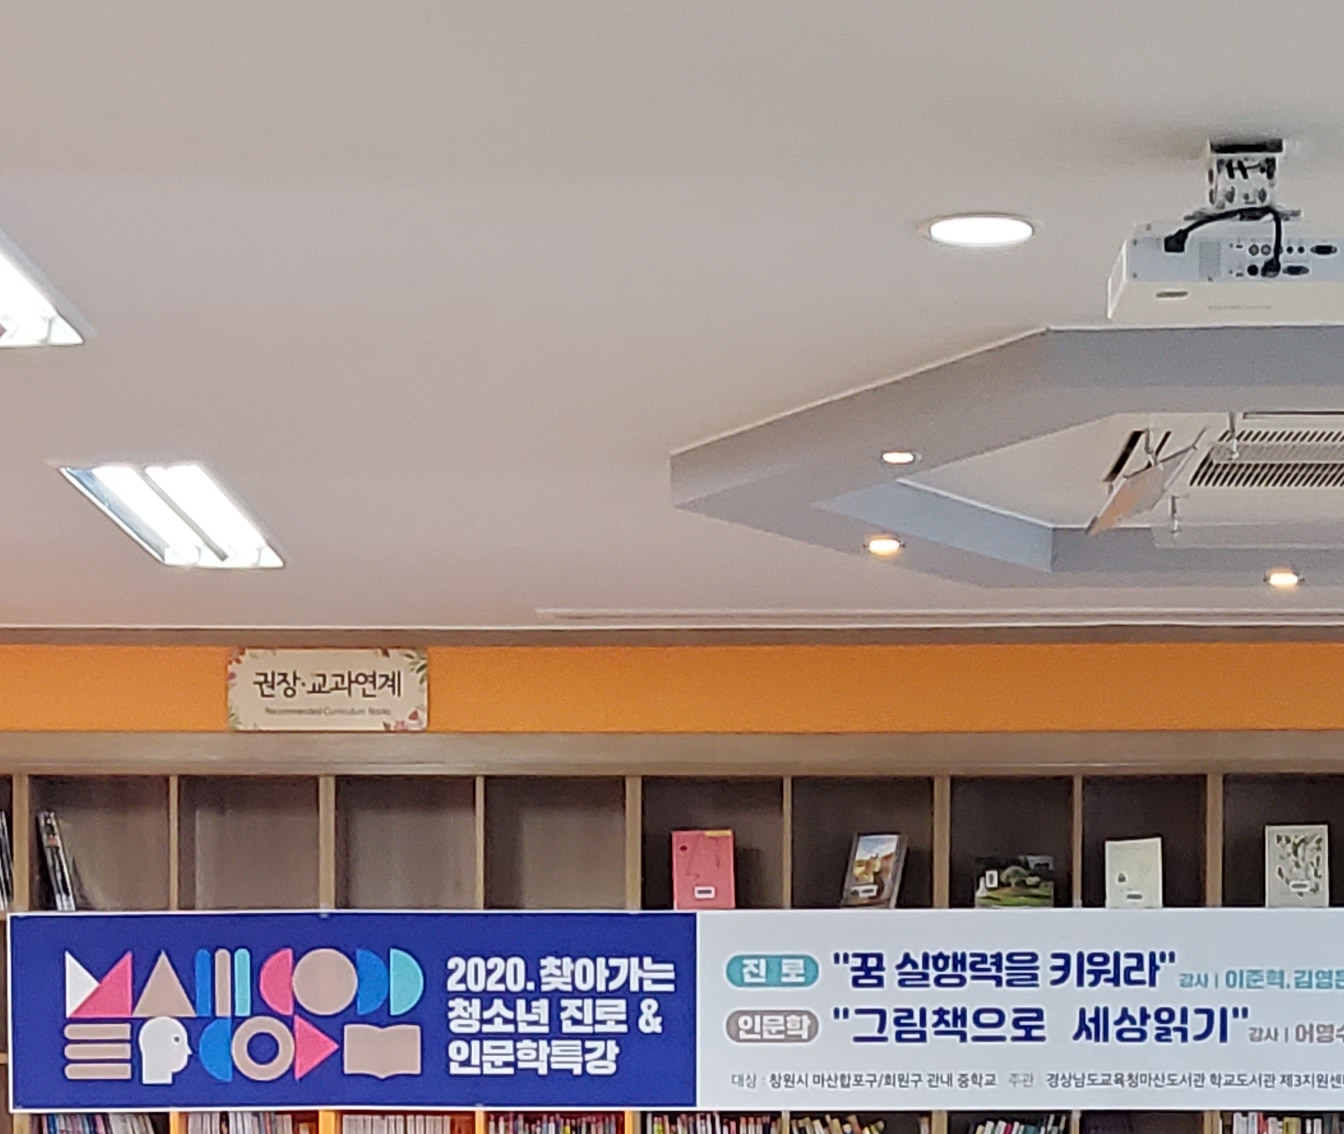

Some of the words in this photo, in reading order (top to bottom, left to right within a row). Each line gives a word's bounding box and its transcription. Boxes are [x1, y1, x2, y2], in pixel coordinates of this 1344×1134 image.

[253, 670, 402, 699] 권장·교과연계
[447, 956, 535, 992] 2020.
[540, 956, 675, 992] 찾아가는
[895, 951, 1040, 988] 실행력을
[1049, 951, 1176, 988] 키워라"
[1179, 972, 1209, 988] 강사
[448, 999, 549, 1033] 청소년
[560, 999, 628, 1033] 진로
[638, 999, 662, 1033] &
[738, 1015, 810, 1039] 인문학
[833, 1006, 1047, 1043] "그림책으로
[1072, 1006, 1249, 1043] 세상읽기"
[1248, 1027, 1279, 1043] 강사
[448, 1039, 620, 1076] 인문학특강
[731, 1073, 757, 1088] 대상
[769, 1072, 809, 1089] 창원시
[926, 1072, 954, 1089] 관내
[956, 1072, 998, 1089] 중학교
[1008, 1072, 1035, 1088] 주관
[1209, 1072, 1277, 1089] 학교도서관
